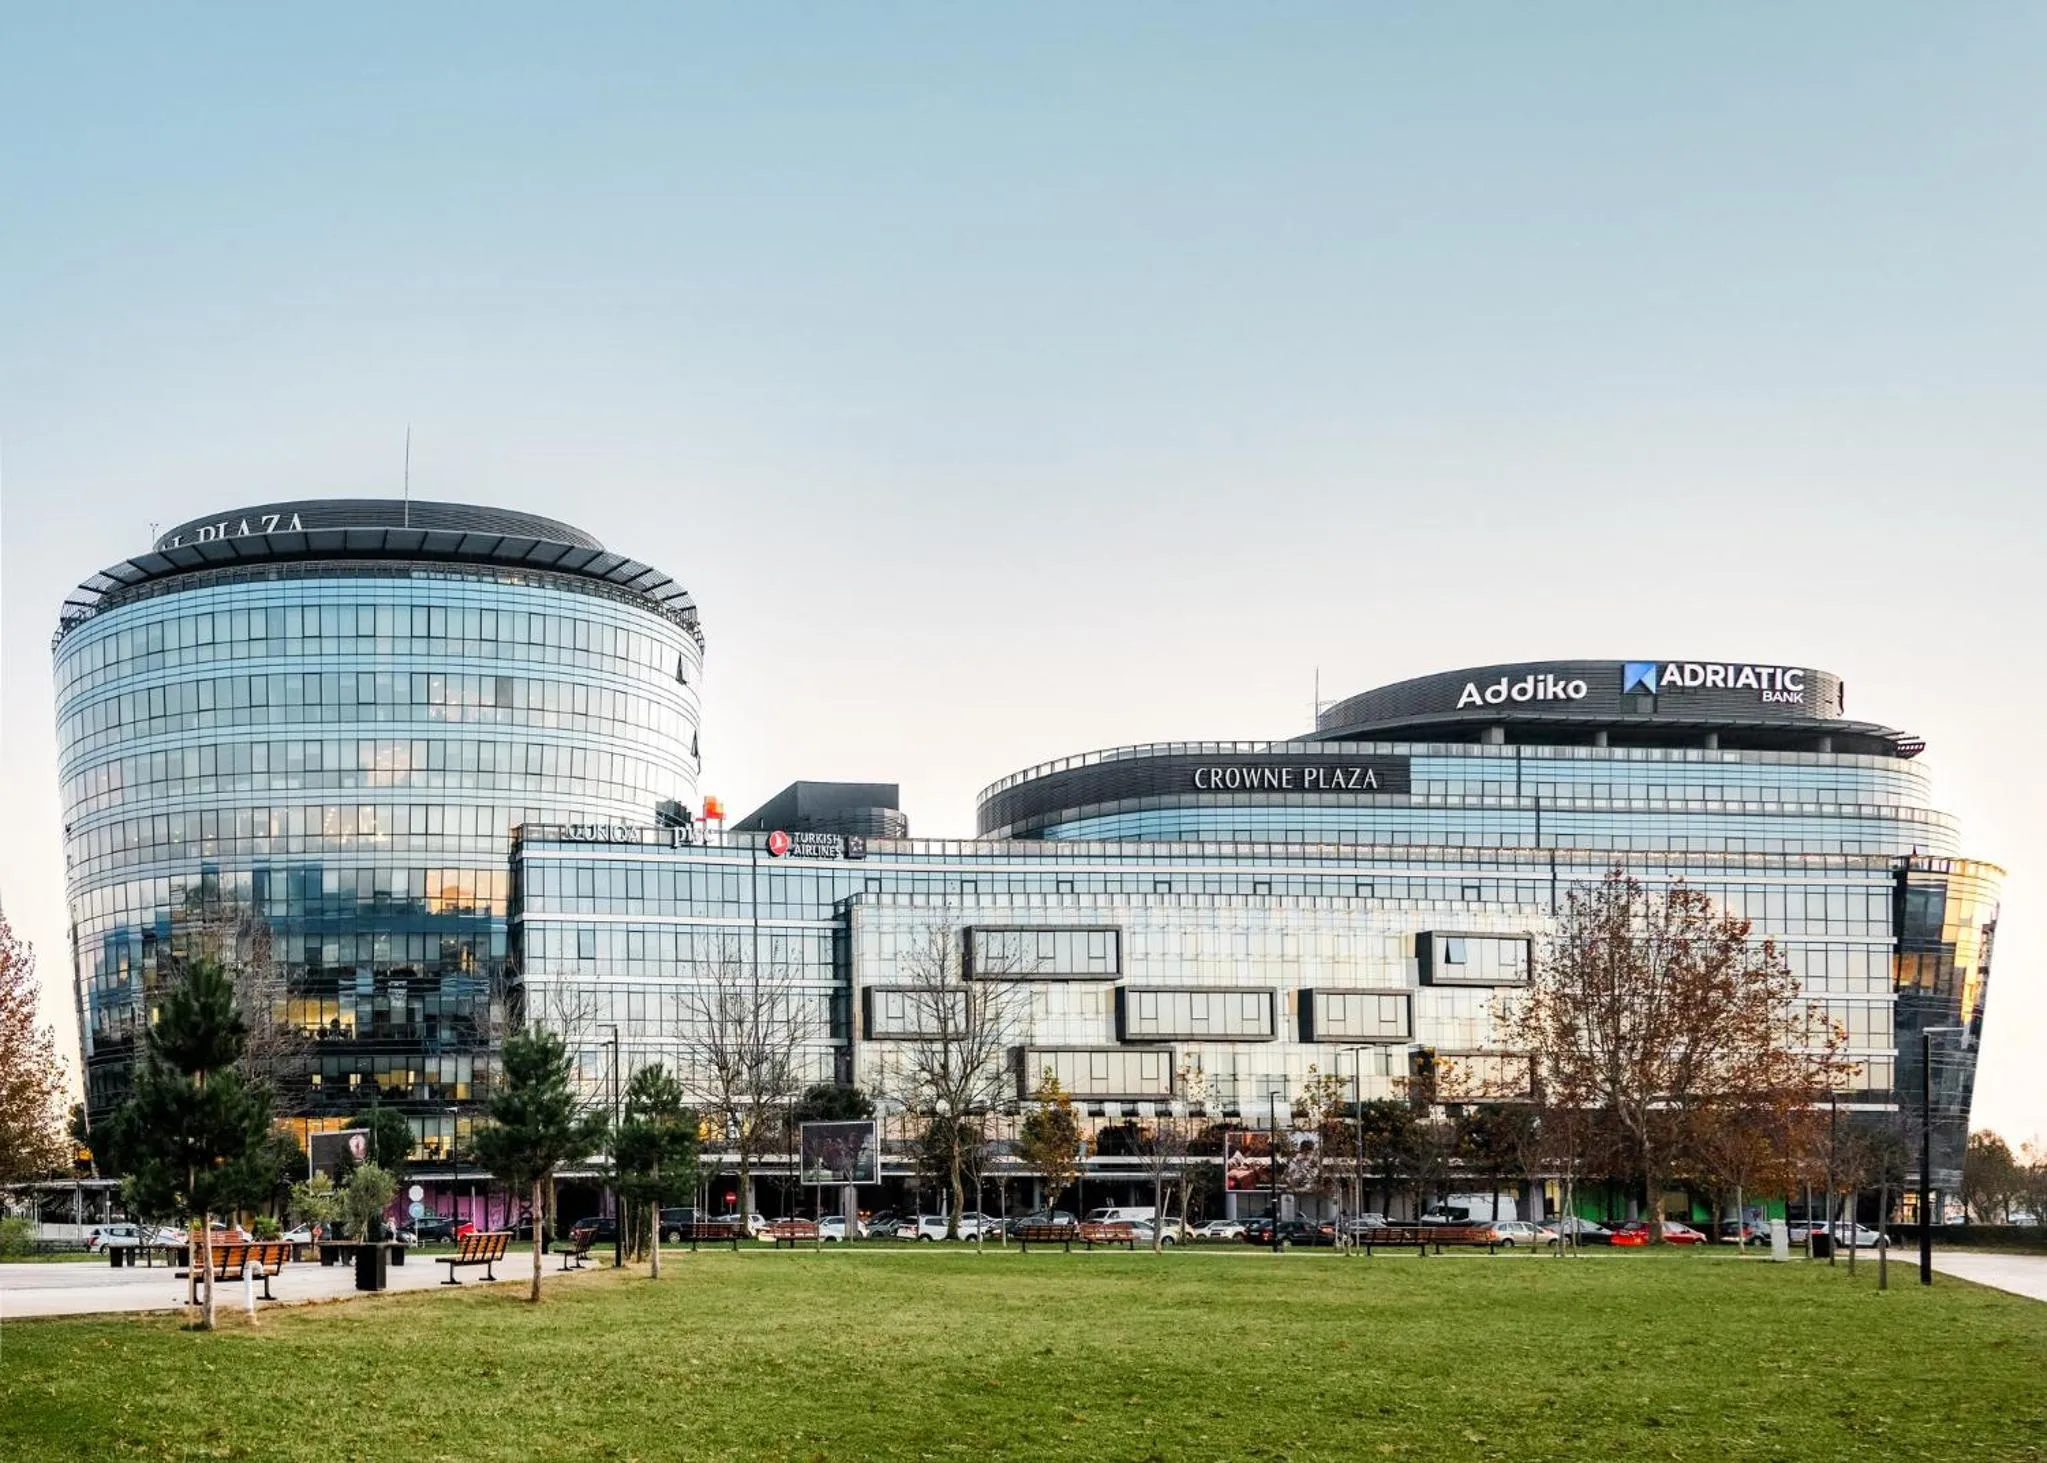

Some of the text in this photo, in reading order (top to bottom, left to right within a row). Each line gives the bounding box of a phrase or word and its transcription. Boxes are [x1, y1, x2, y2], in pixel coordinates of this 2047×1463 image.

[1659, 662, 1805, 691] ADRIATIC
[1456, 674, 1588, 709] Addiko
[1762, 690, 1804, 703] BANK
[1194, 768, 1379, 789] CROWNE PLAZA
[794, 832, 841, 845] TURKISH
[793, 844, 841, 857] AIRLINES
